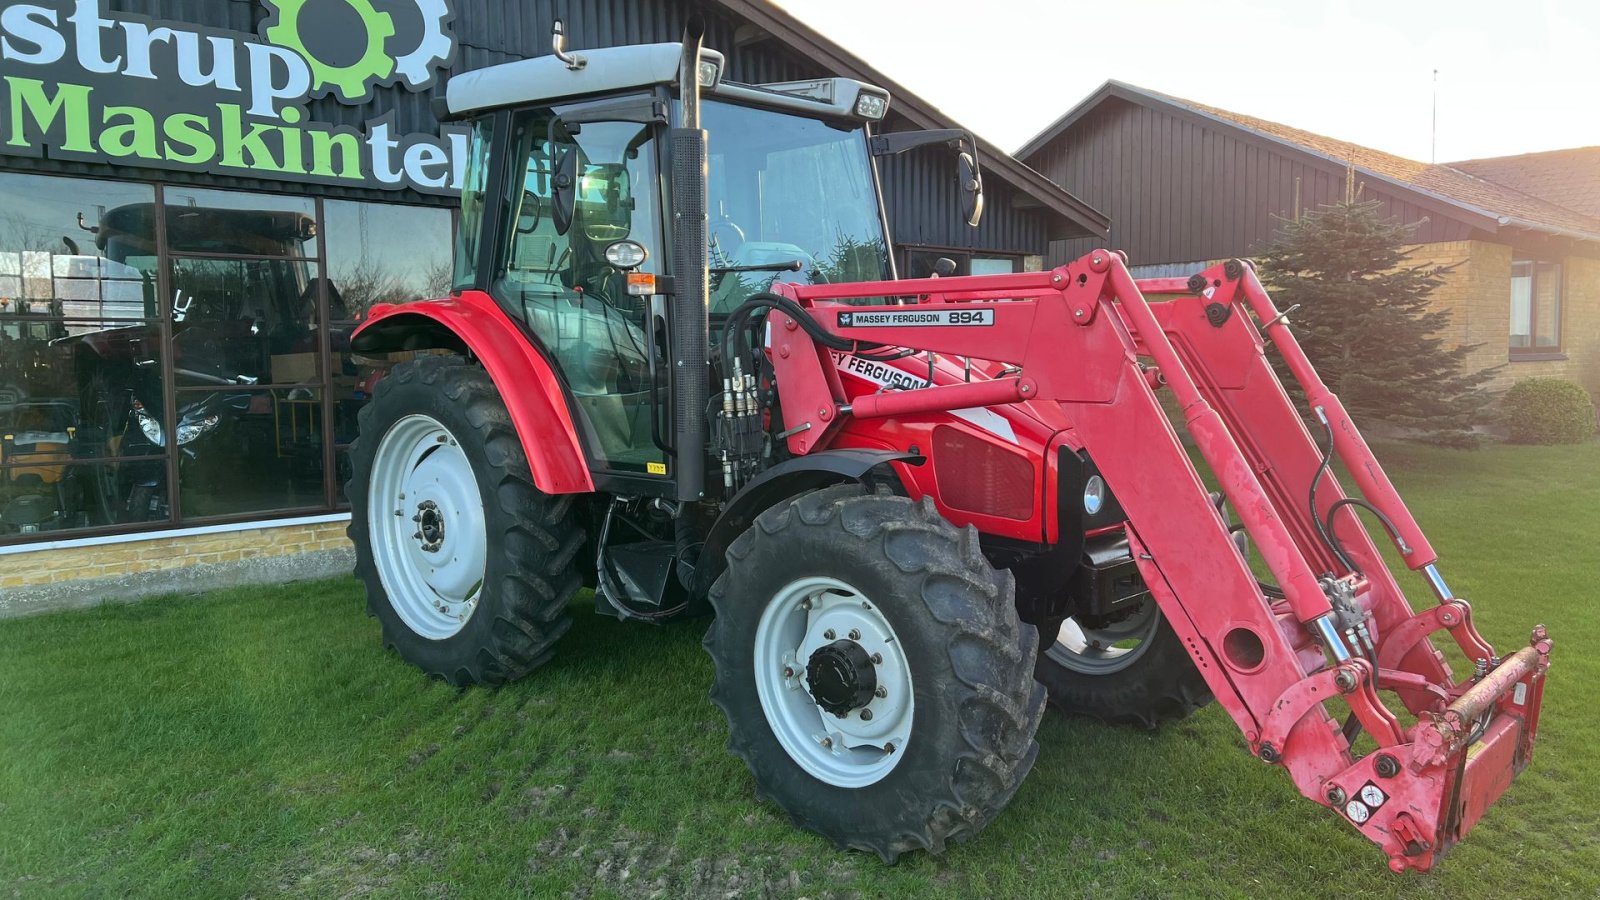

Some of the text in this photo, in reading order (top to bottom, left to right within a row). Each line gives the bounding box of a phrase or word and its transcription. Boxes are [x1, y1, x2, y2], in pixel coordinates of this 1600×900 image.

[855, 311, 984, 324] MASSEY FERGUSON 894
[847, 356, 925, 390] FERGUSON
